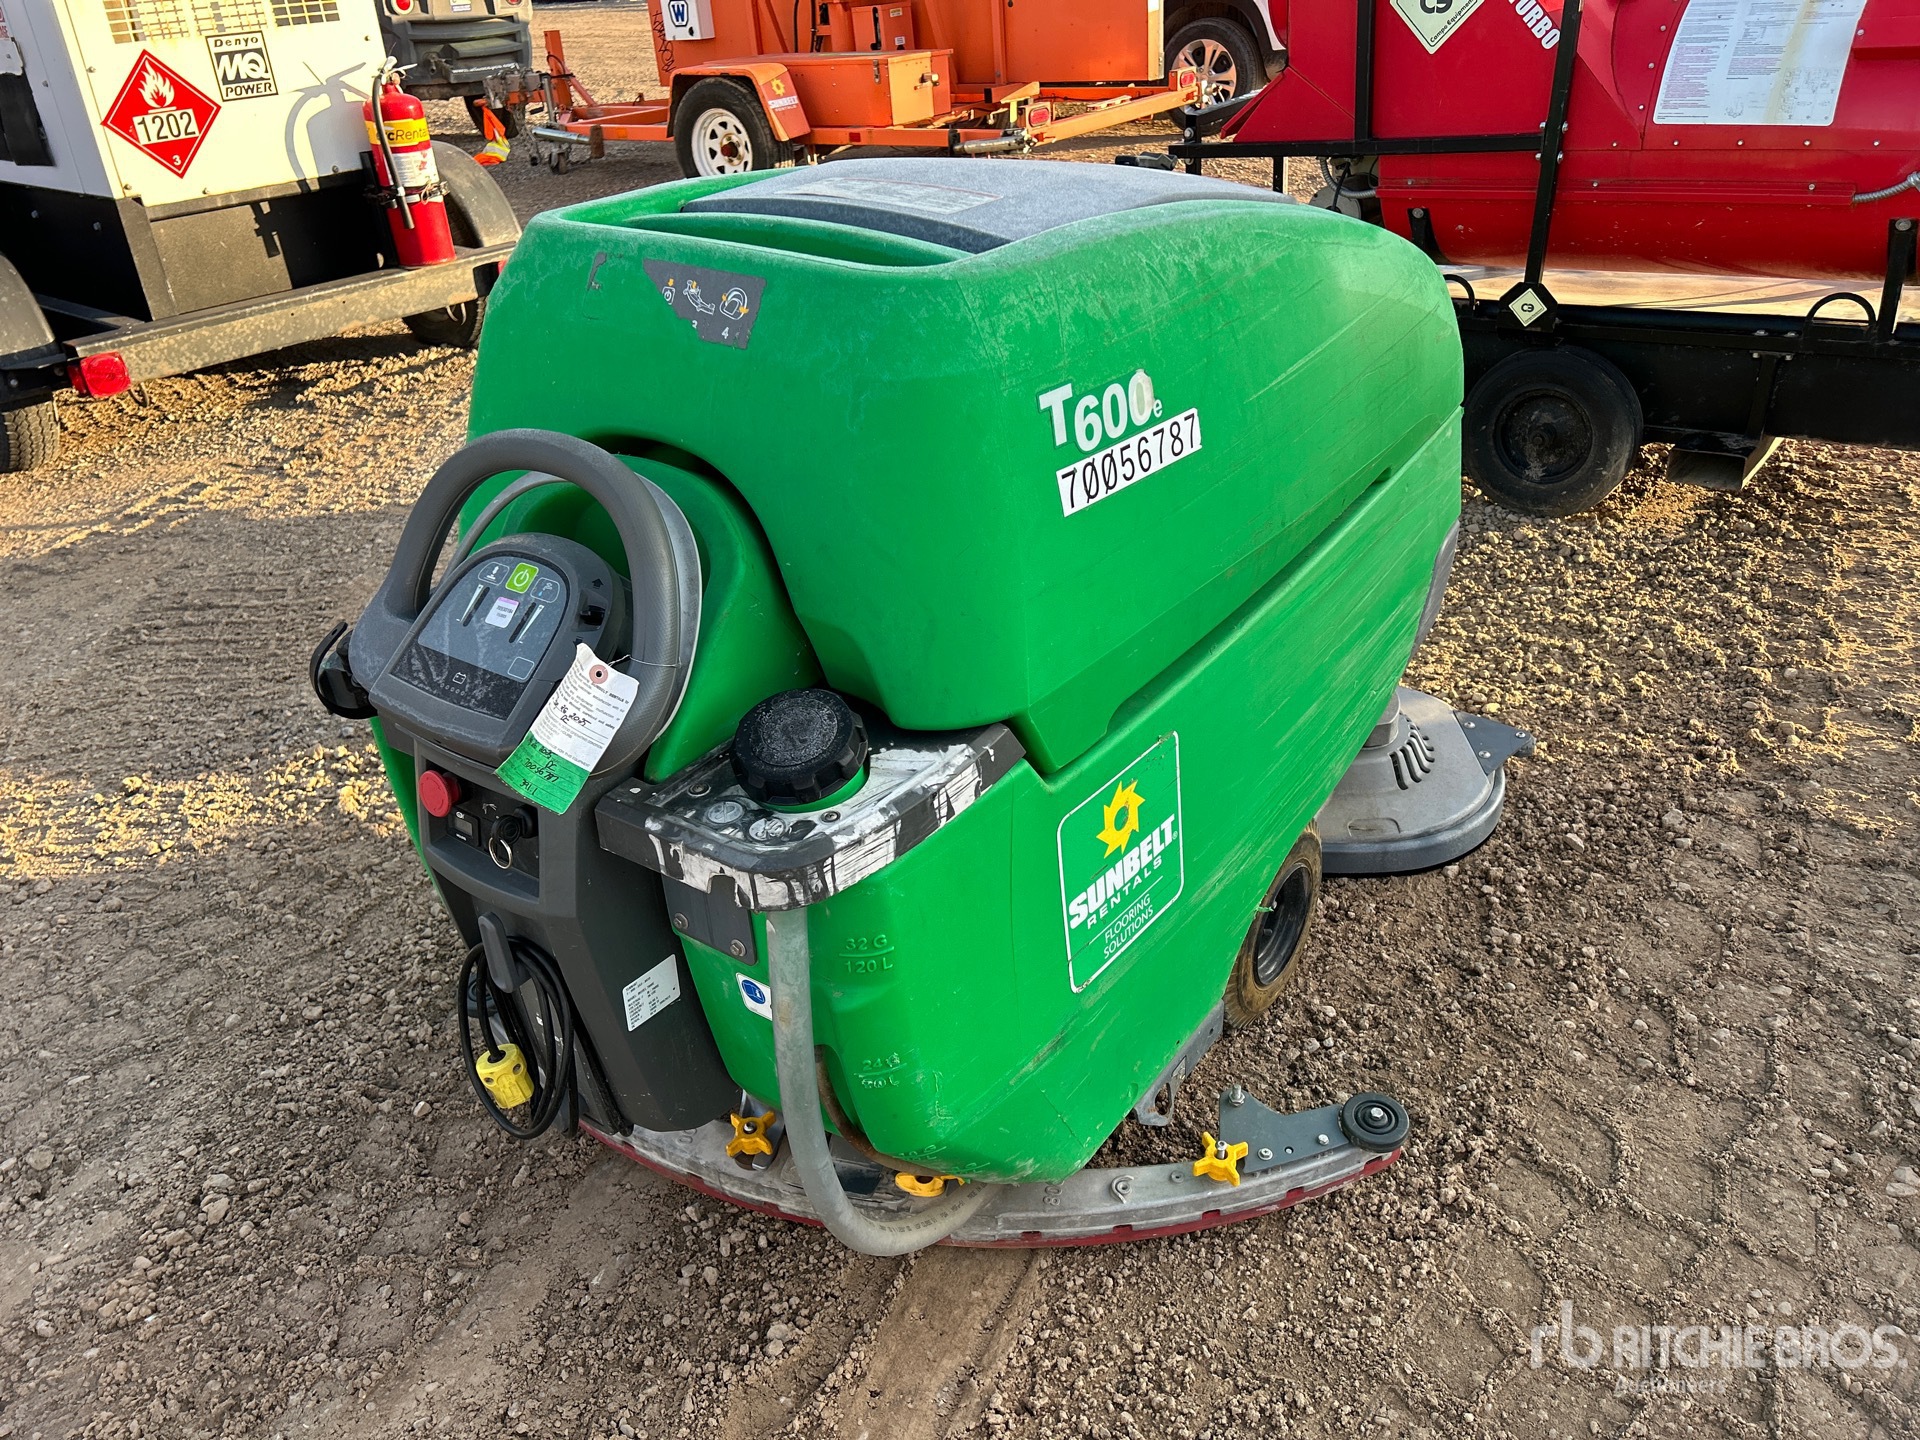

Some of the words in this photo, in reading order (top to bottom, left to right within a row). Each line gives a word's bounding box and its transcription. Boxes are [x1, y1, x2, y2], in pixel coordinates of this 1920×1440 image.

[671, 3, 685, 22] W
[1430, 25, 1449, 43] Campo
[1507, 0, 1561, 50] URBO
[213, 36, 259, 48] Denyo
[216, 52, 271, 82] MQ
[225, 82, 273, 98] POWER
[137, 111, 197, 142] 1202
[172, 155, 182, 166] 3
[721, 327, 730, 340] 4
[1061, 413, 1196, 509] 70056787
[1068, 813, 1175, 930] SUNBELT
[1087, 855, 1163, 930] RENTALS
[1104, 893, 1151, 944] FLOORING
[1103, 905, 1154, 959] SOLUTIONS
[845, 937, 868, 951] 32
[873, 934, 888, 948] G
[845, 958, 877, 974] 120
[882, 956, 894, 970] L
[861, 1057, 883, 1072] 24
